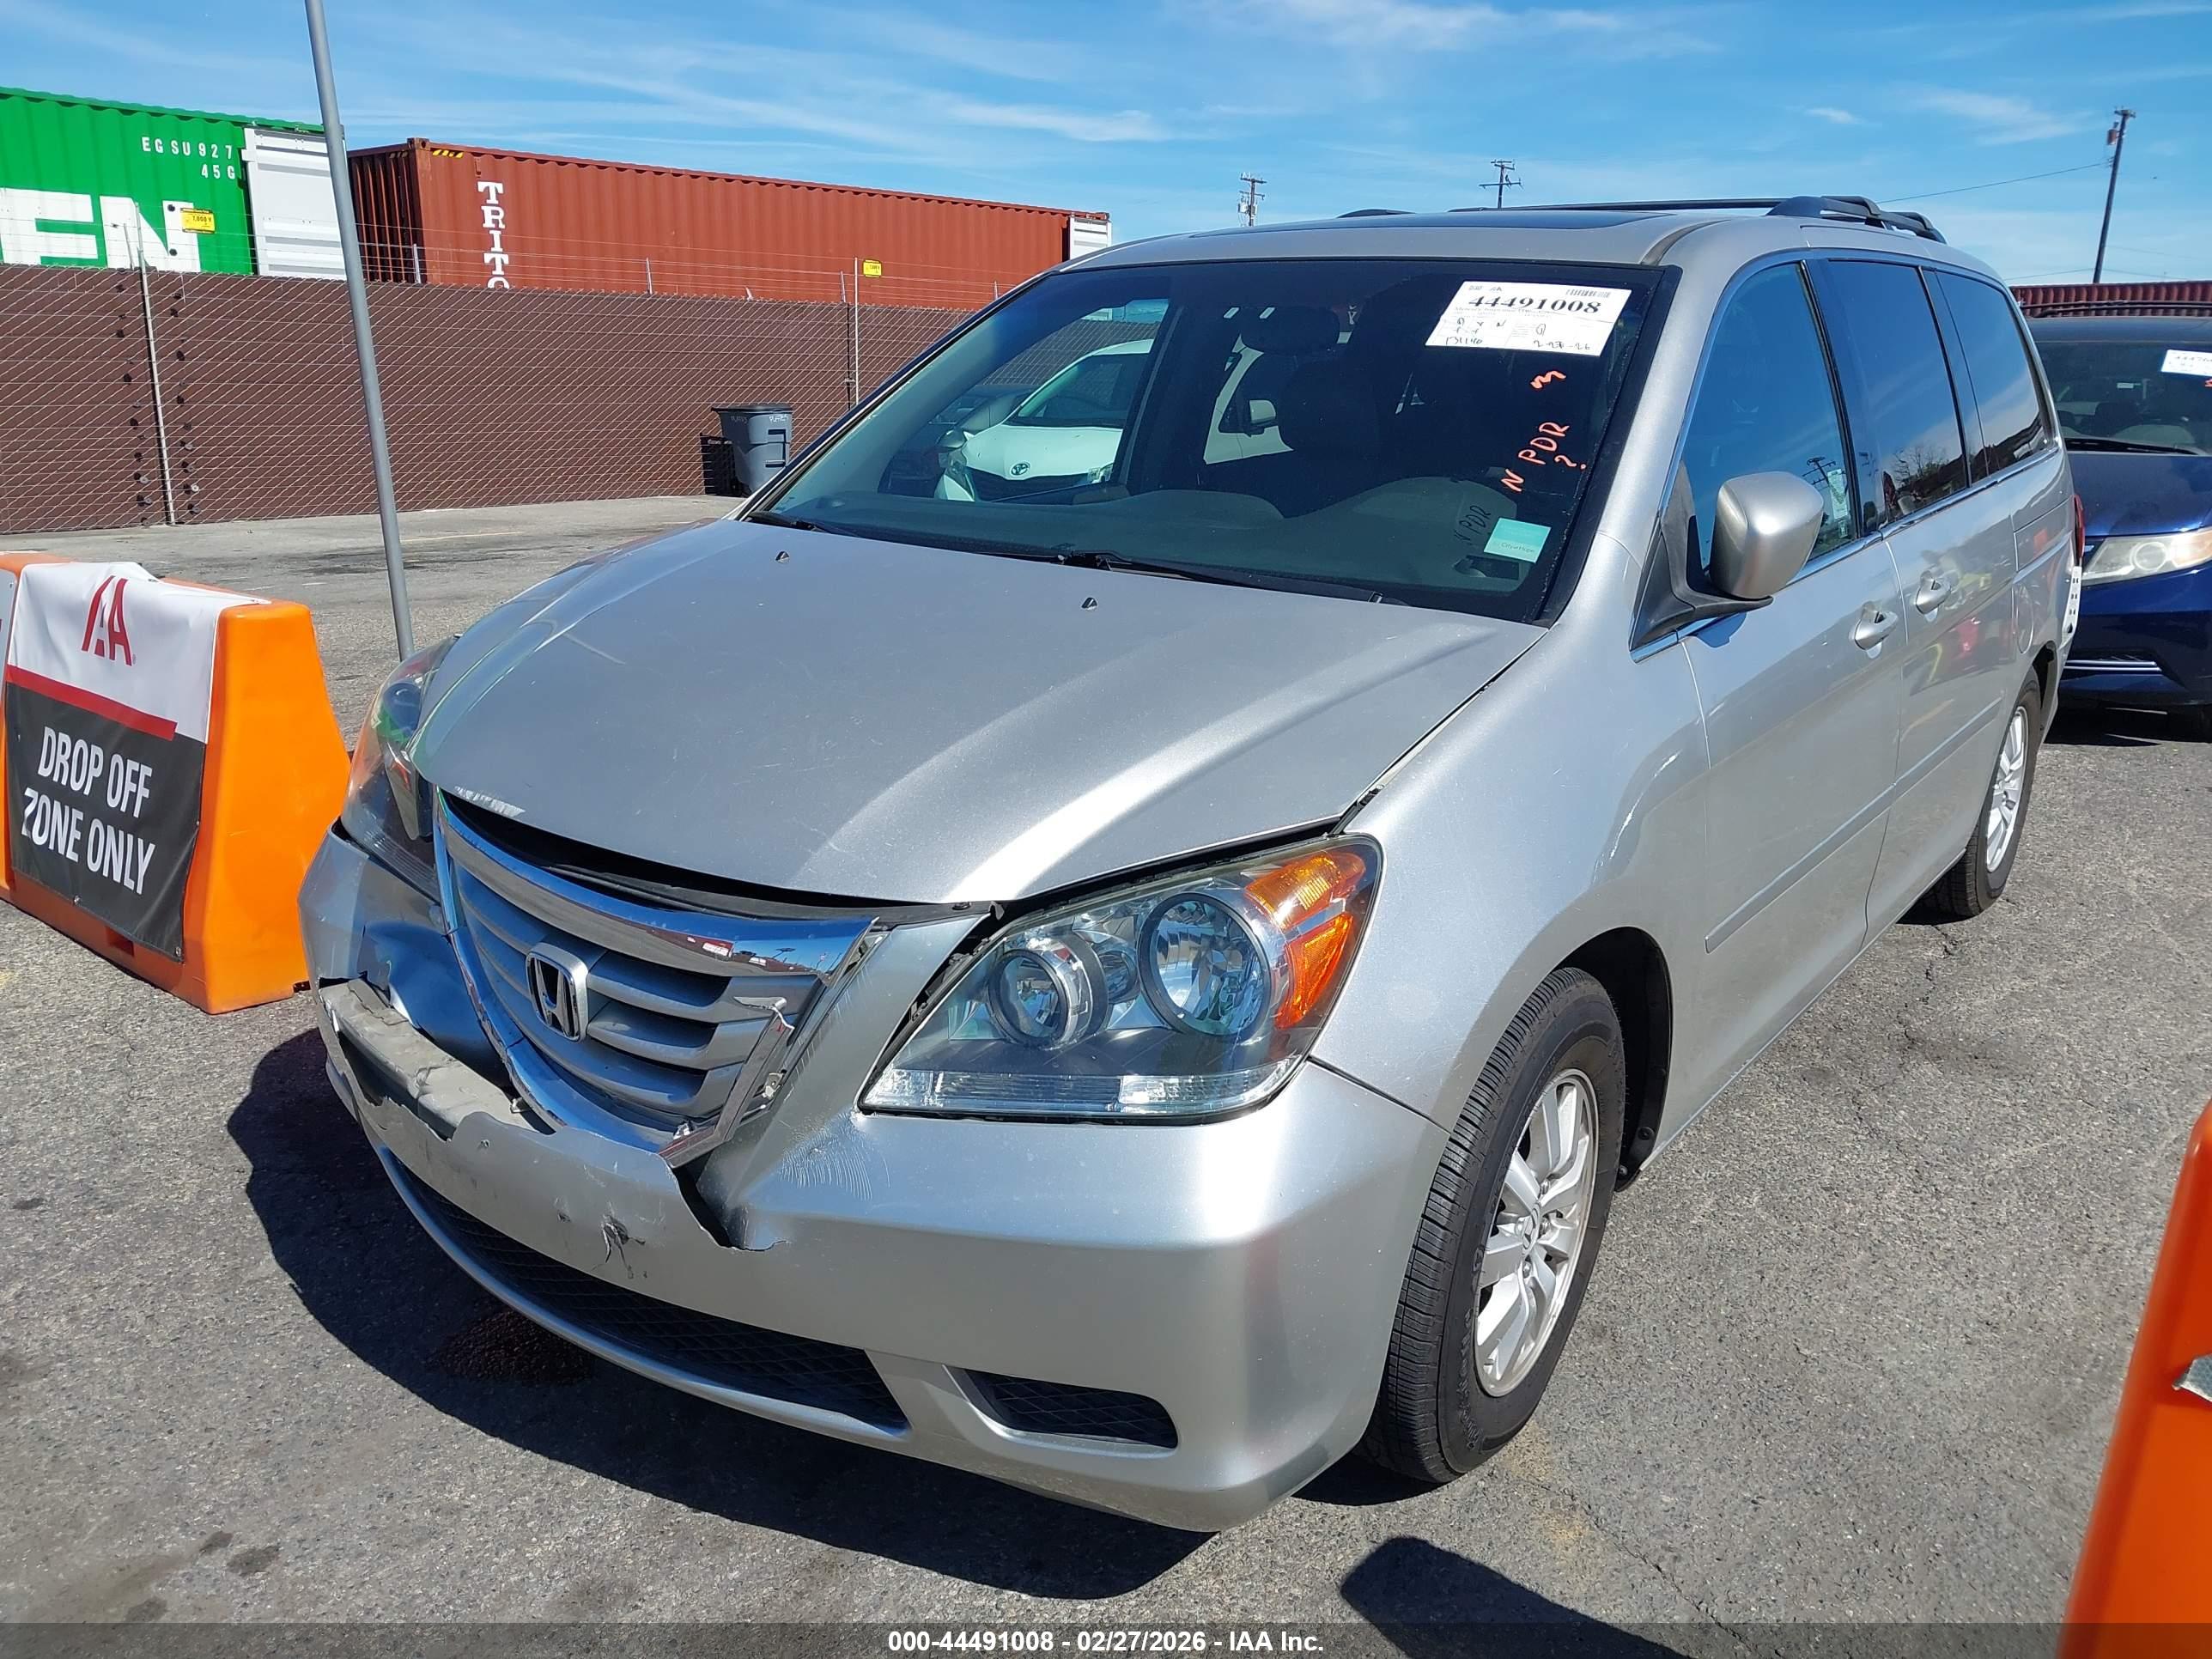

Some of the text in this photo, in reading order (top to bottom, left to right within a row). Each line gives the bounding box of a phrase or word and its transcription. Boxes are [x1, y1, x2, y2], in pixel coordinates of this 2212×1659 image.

[1468, 295, 1601, 314] 44491008
[1517, 422, 1570, 465] PDR
[38, 726, 153, 818] DROP OFF
[21, 787, 156, 895] ZONE ONLY
